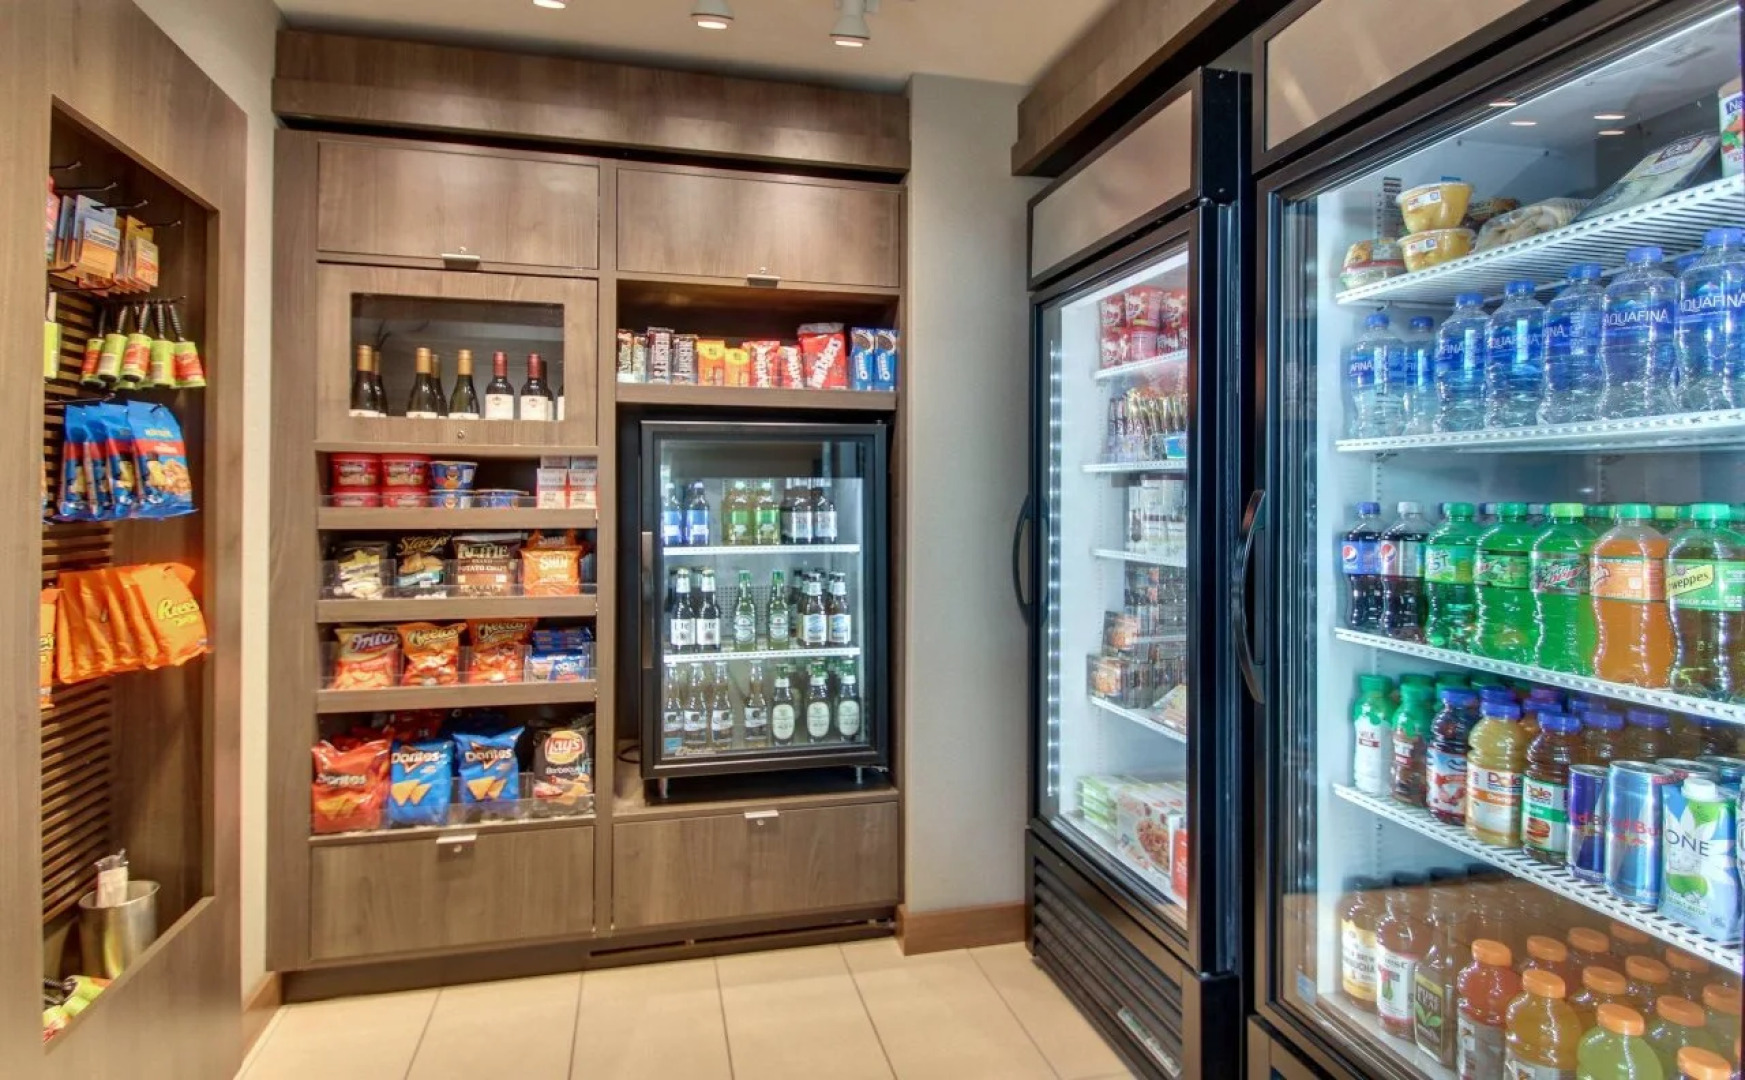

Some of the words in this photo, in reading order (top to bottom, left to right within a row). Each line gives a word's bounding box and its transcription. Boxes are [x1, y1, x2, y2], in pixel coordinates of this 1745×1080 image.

[1604, 309, 1669, 326] AQUAFINA
[1668, 571, 1710, 591] weppes
[392, 751, 441, 764] Doritos
[465, 748, 513, 763] Doritos
[316, 773, 367, 786] Doritos
[1526, 784, 1552, 798] Dole
[1665, 828, 1709, 857] ONE
